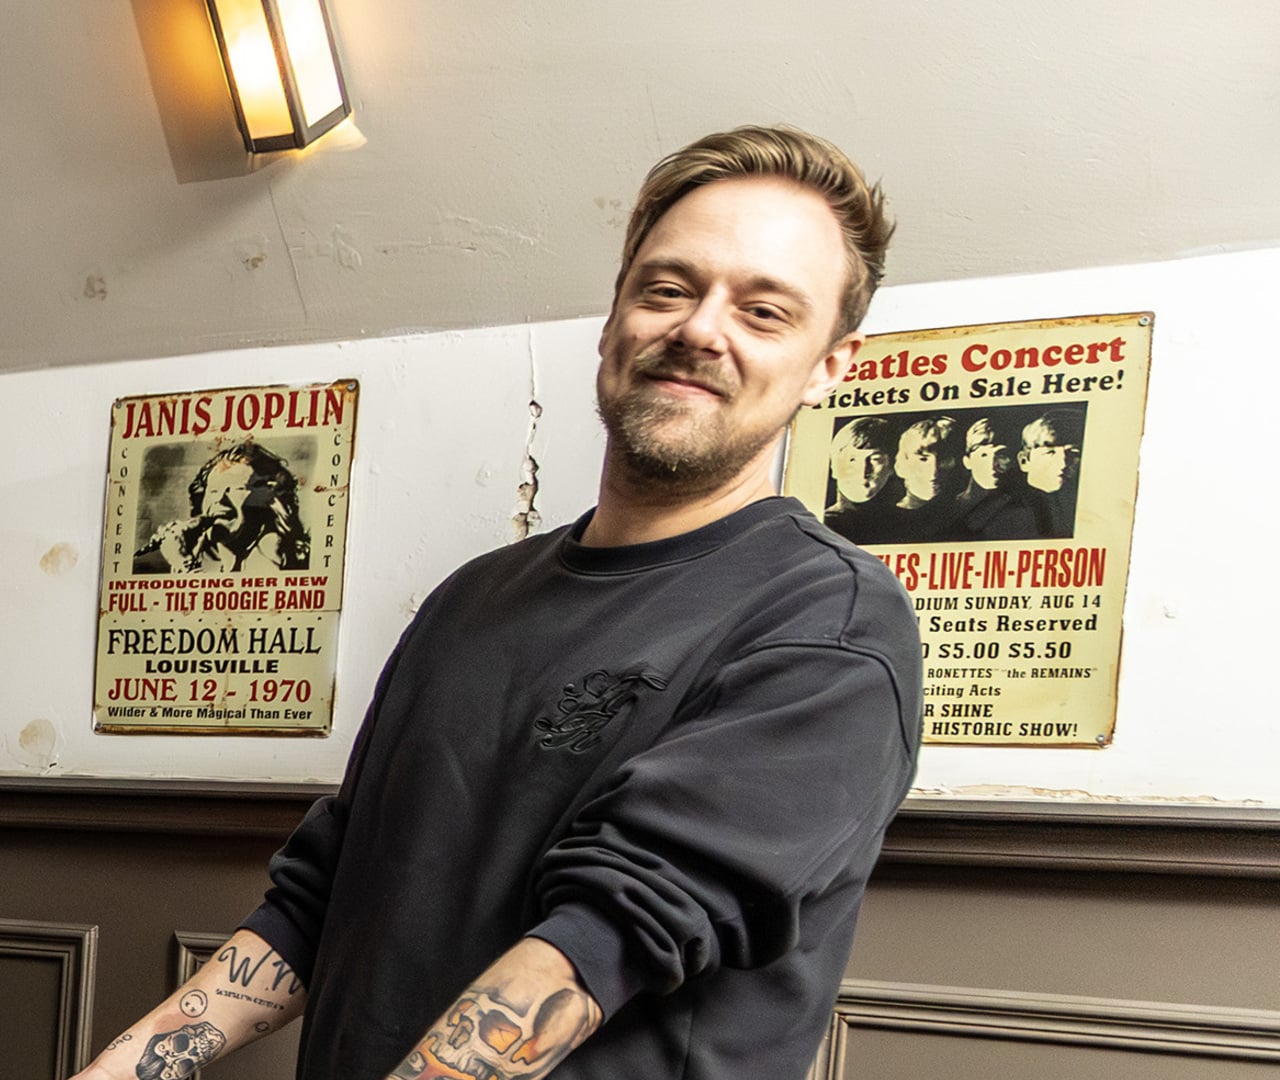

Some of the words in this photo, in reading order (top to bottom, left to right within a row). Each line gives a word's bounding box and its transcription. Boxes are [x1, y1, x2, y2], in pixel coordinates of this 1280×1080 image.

[842, 350, 948, 383] eatles
[961, 337, 1127, 372] Concert
[919, 381, 960, 402] On
[969, 376, 1031, 398] Sale
[1041, 369, 1125, 394] Here!
[122, 396, 213, 438] JANIS
[221, 389, 345, 432] JOPLIN
[323, 433, 341, 568] CONCERT
[112, 448, 128, 574] CONCERT
[108, 577, 235, 590] INTRODUCING
[241, 577, 278, 588] HER
[284, 576, 328, 587] NEW
[108, 593, 147, 612] FULL
[165, 591, 198, 611] TILT
[203, 590, 269, 611] BOOGIE
[274, 589, 326, 610] BAND
[915, 596, 959, 610] DIUM
[1040, 594, 1075, 609] AUG
[1082, 594, 1101, 608] 14
[929, 616, 988, 632] Seats
[996, 614, 1098, 632] Reserved
[107, 627, 240, 655] FREEDOM
[248, 626, 322, 654] HALL
[145, 660, 279, 674] LOUISVILLE
[108, 678, 178, 702] JUNE
[189, 679, 218, 702] 12
[249, 679, 312, 703] 1970
[922, 684, 964, 698] citing
[969, 684, 1001, 696] Acts
[107, 706, 146, 719] Wilder
[149, 707, 158, 719] &
[162, 707, 193, 719] More
[196, 708, 246, 721] Magical
[250, 708, 280, 720] Than
[284, 708, 313, 721] Ever
[923, 703, 934, 717] R
[941, 703, 994, 717] SHINE
[931, 722, 1013, 736] HISTORIC
[1019, 722, 1078, 737] SHOW!
